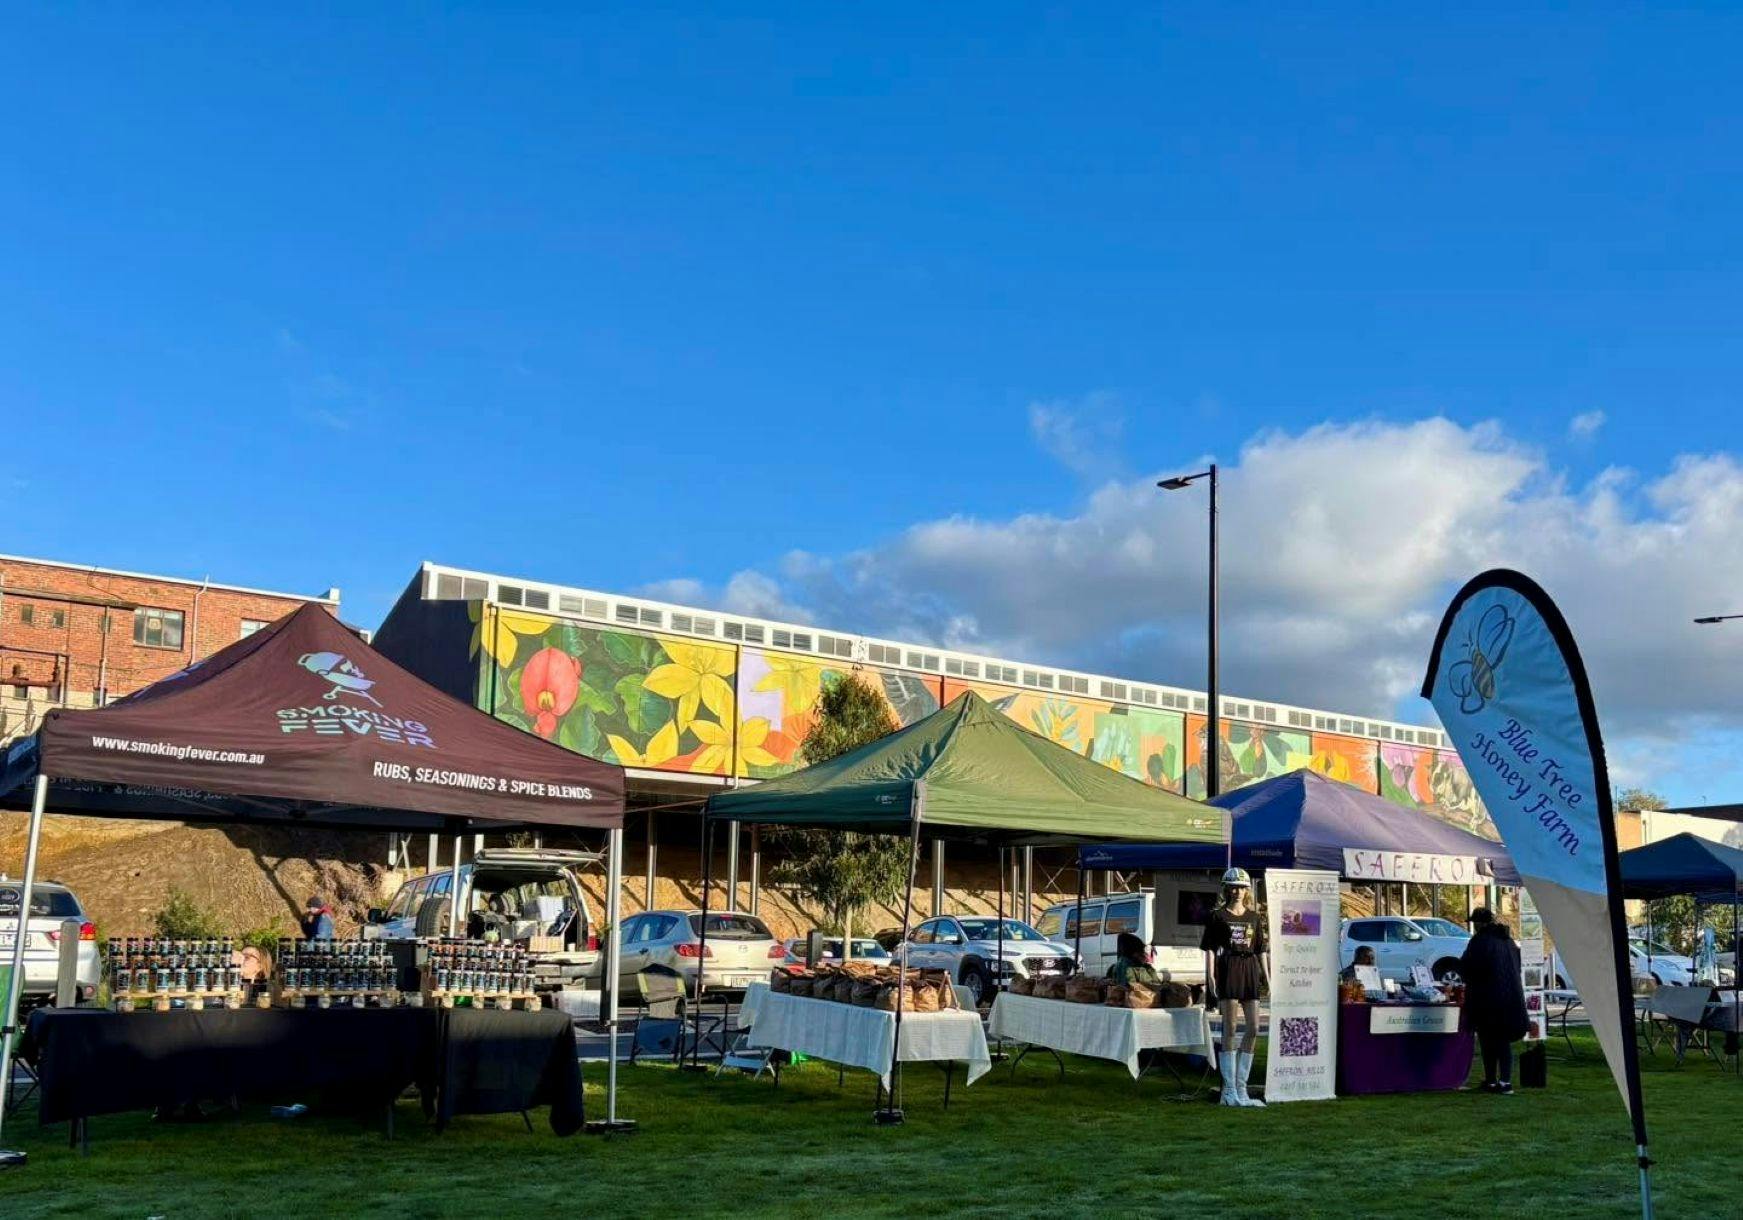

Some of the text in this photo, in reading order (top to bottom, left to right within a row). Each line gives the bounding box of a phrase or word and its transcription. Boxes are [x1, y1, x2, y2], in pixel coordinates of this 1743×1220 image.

[276, 704, 428, 733] SMOKING
[279, 718, 439, 750] FEVER
[92, 735, 265, 764] www.smokingfever.com.au
[1498, 718, 1583, 810] Blue Tree
[373, 761, 593, 800] RUBS, SEASONINGS & SPICE BLENDS
[1471, 732, 1580, 856] Honey Farm
